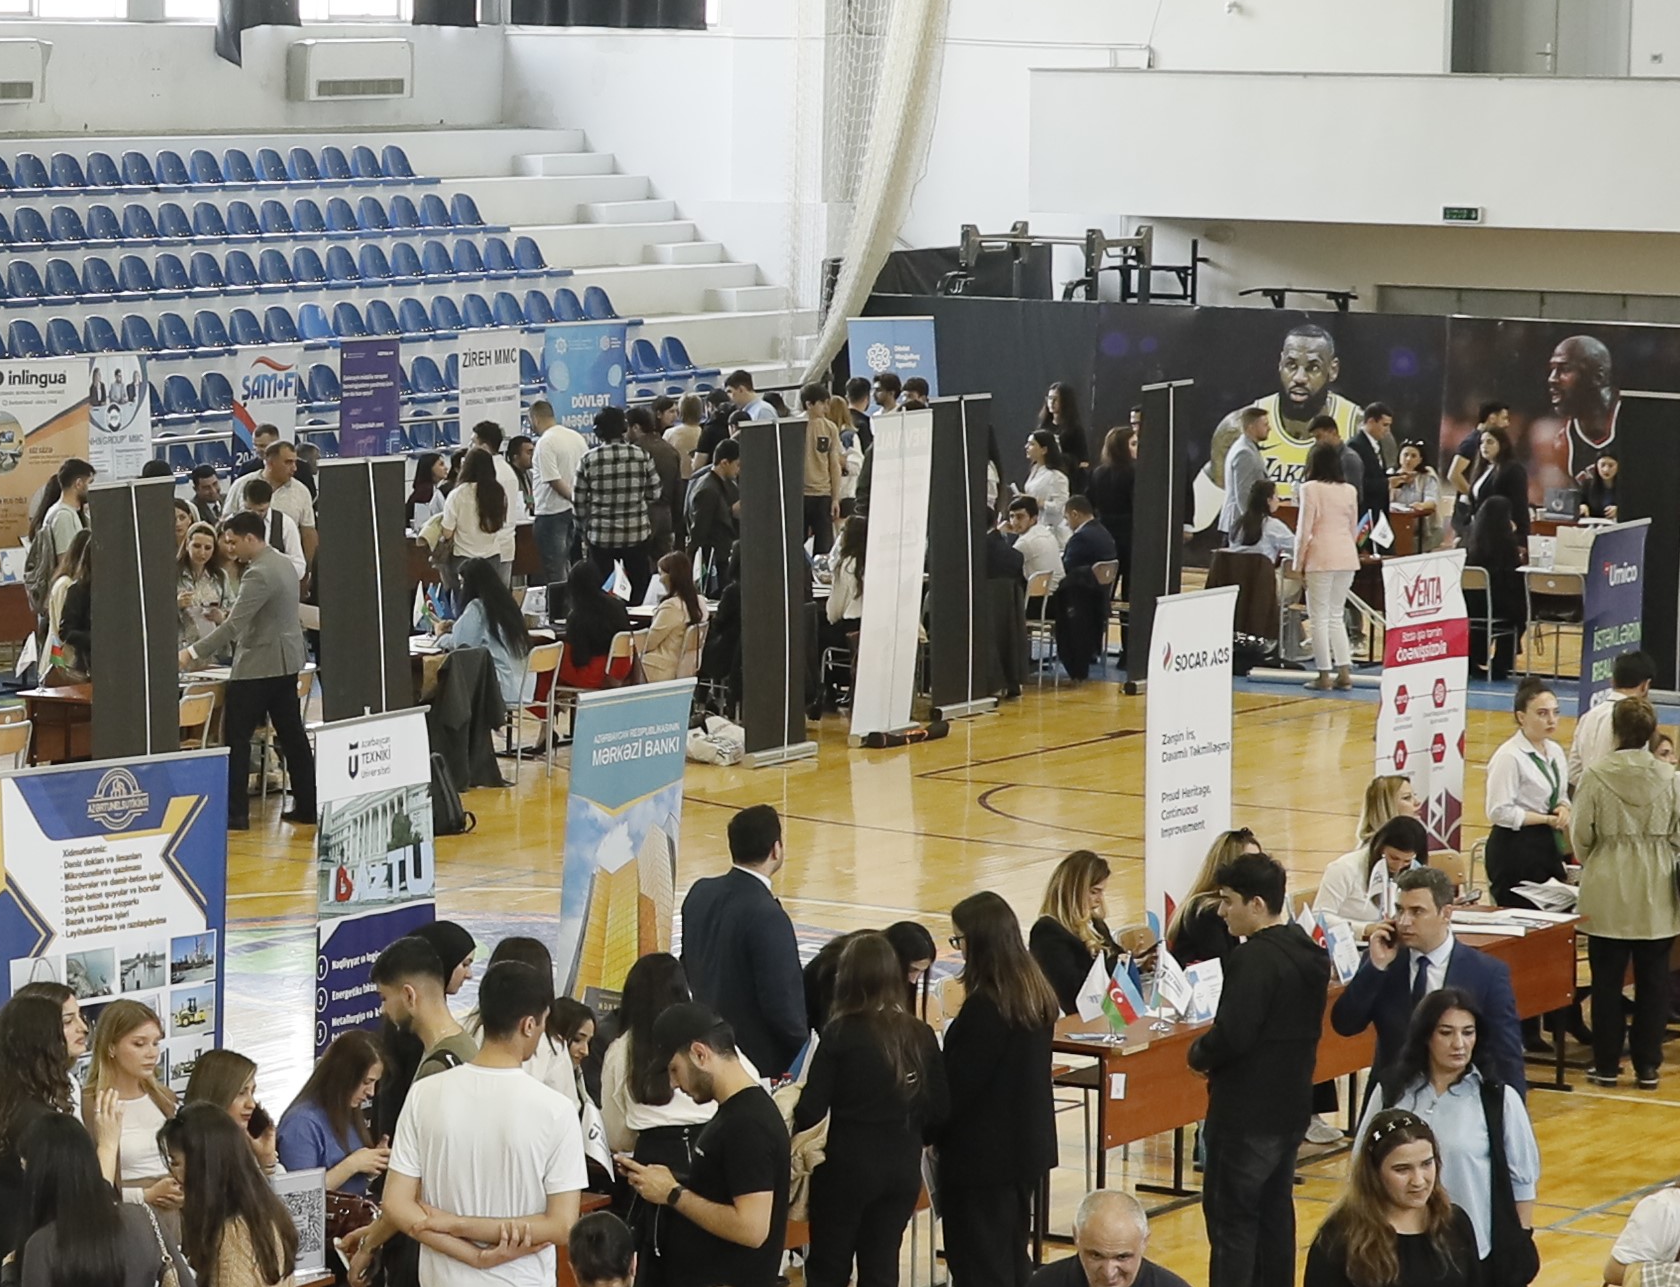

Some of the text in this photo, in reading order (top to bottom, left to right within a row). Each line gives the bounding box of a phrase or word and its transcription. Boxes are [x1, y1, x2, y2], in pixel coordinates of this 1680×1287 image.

[463, 348, 517, 367] ZİREH MMC
[9, 370, 67, 388] inlingua
[1609, 562, 1638, 586] Umico
[1404, 575, 1441, 609] VENTA
[1175, 652, 1207, 672] SOCAR
[592, 736, 679, 766] MƏRKƏZİ BANKI
[1161, 820, 1205, 838] Improvement
